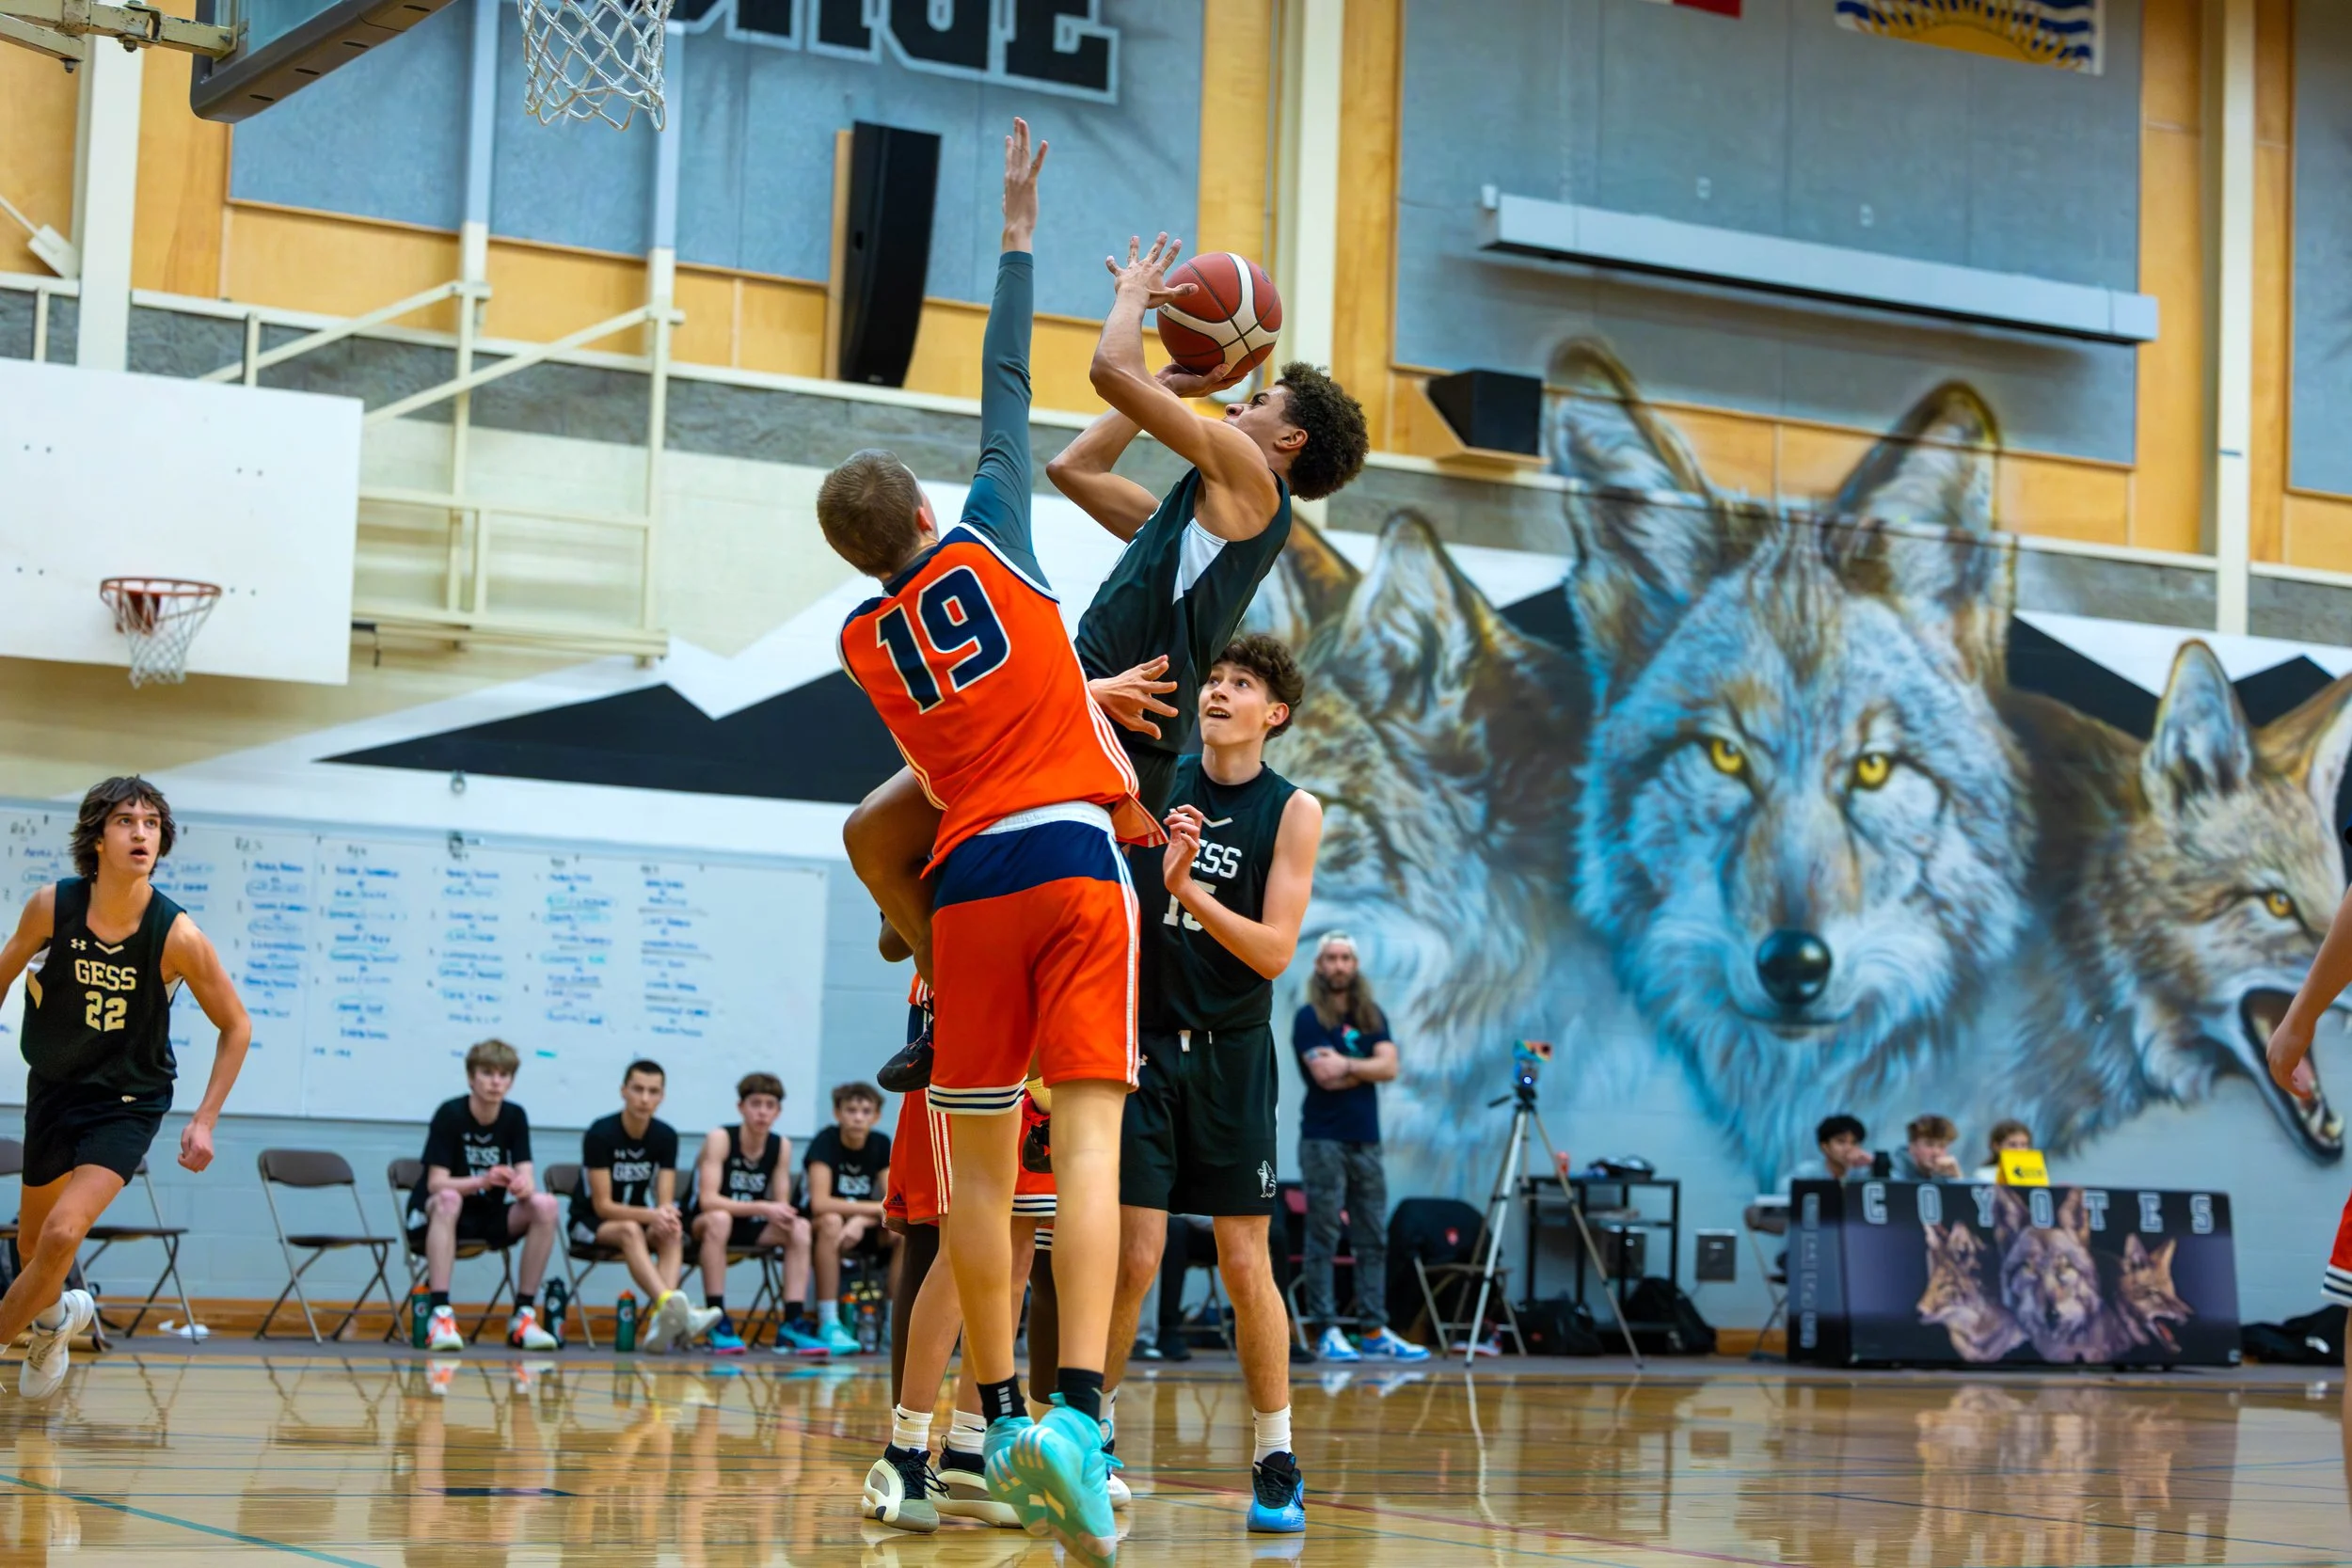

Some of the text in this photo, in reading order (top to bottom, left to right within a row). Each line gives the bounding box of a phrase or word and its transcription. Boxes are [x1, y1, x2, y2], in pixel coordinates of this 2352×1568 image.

[875, 564, 1011, 715] 19
[74, 958, 137, 990] GESS
[85, 990, 127, 1032] 22
[612, 1161, 652, 1181] GESS
[728, 1170, 767, 1192] GESS
[1862, 1182, 2214, 1234] COYOTES
